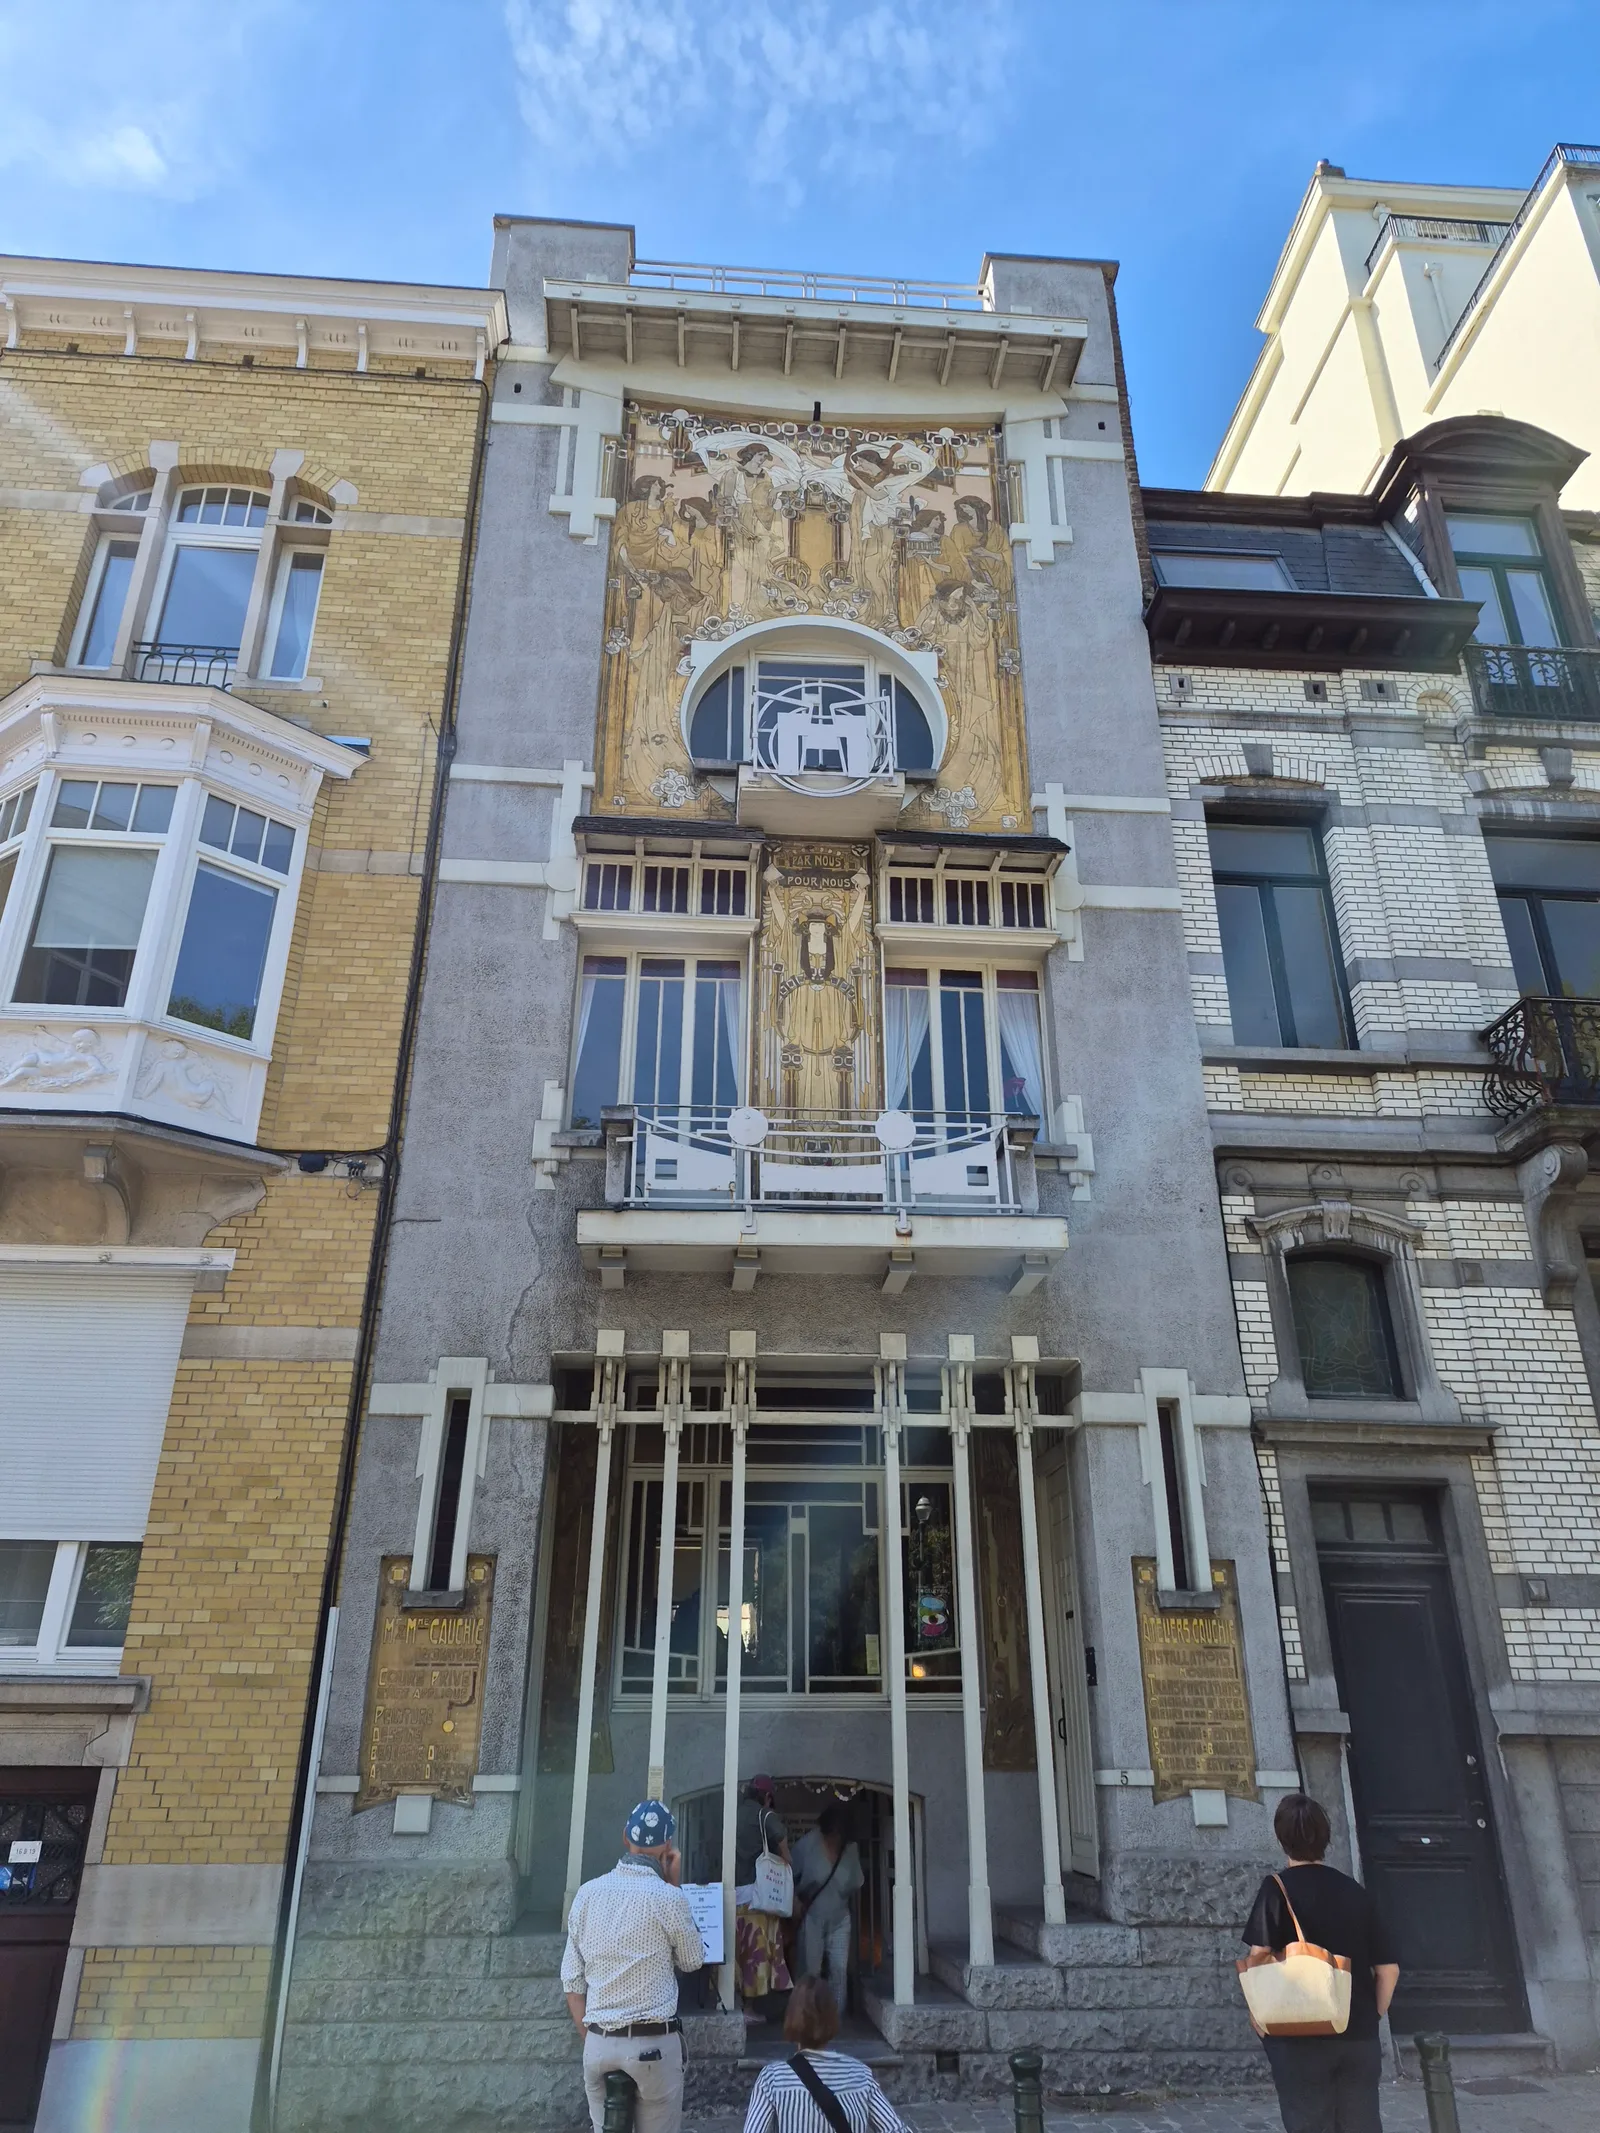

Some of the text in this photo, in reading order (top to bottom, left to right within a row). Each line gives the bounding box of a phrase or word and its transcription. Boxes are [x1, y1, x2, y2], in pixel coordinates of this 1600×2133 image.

[792, 855, 842, 867] PAR NOUS
[787, 876, 851, 888] POUR NOUS
[429, 1617, 484, 1645] CAUCHIE
[1142, 1613, 1236, 1645] ATELIERS CAUCHIE
[1144, 1648, 1231, 1666] INSTALLATIONS
[378, 1667, 425, 1687] COURS
[1120, 1771, 1129, 1786] 5
